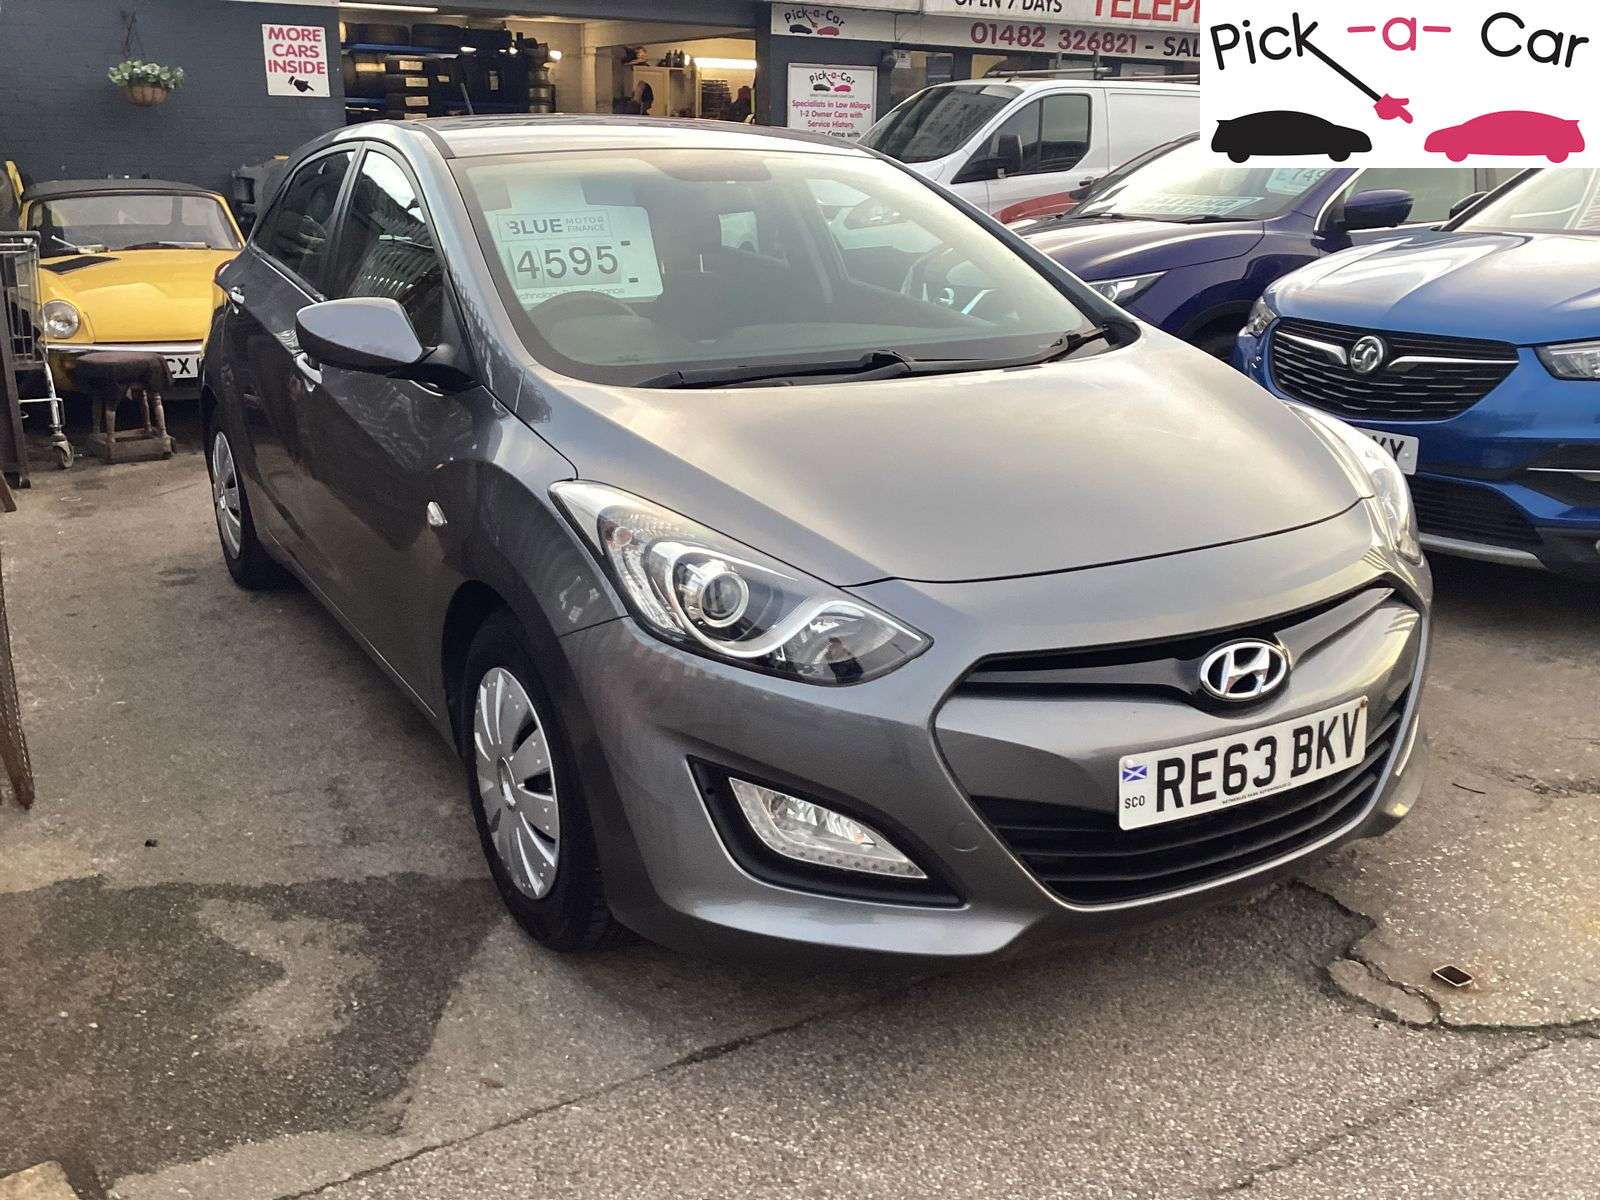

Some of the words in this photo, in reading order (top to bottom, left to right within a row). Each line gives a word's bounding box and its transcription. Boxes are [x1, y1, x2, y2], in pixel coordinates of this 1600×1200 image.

[1022, 0, 1062, 13] DAYS
[1095, 0, 1200, 23] TELEP
[268, 27, 321, 42] MORE
[970, 22, 1046, 48] 01482
[1058, 29, 1137, 54] 326821
[272, 44, 320, 58] CARS
[267, 60, 326, 75] INSIDE
[812, 110, 832, 118] Owner
[834, 110, 848, 118] Cars
[808, 120, 831, 128] Service
[505, 218, 563, 235] BLUE
[516, 245, 618, 280] 4595
[1156, 735, 1277, 812] RE63
[1290, 709, 1360, 778] BKV
[1124, 795, 1146, 809] SCO
